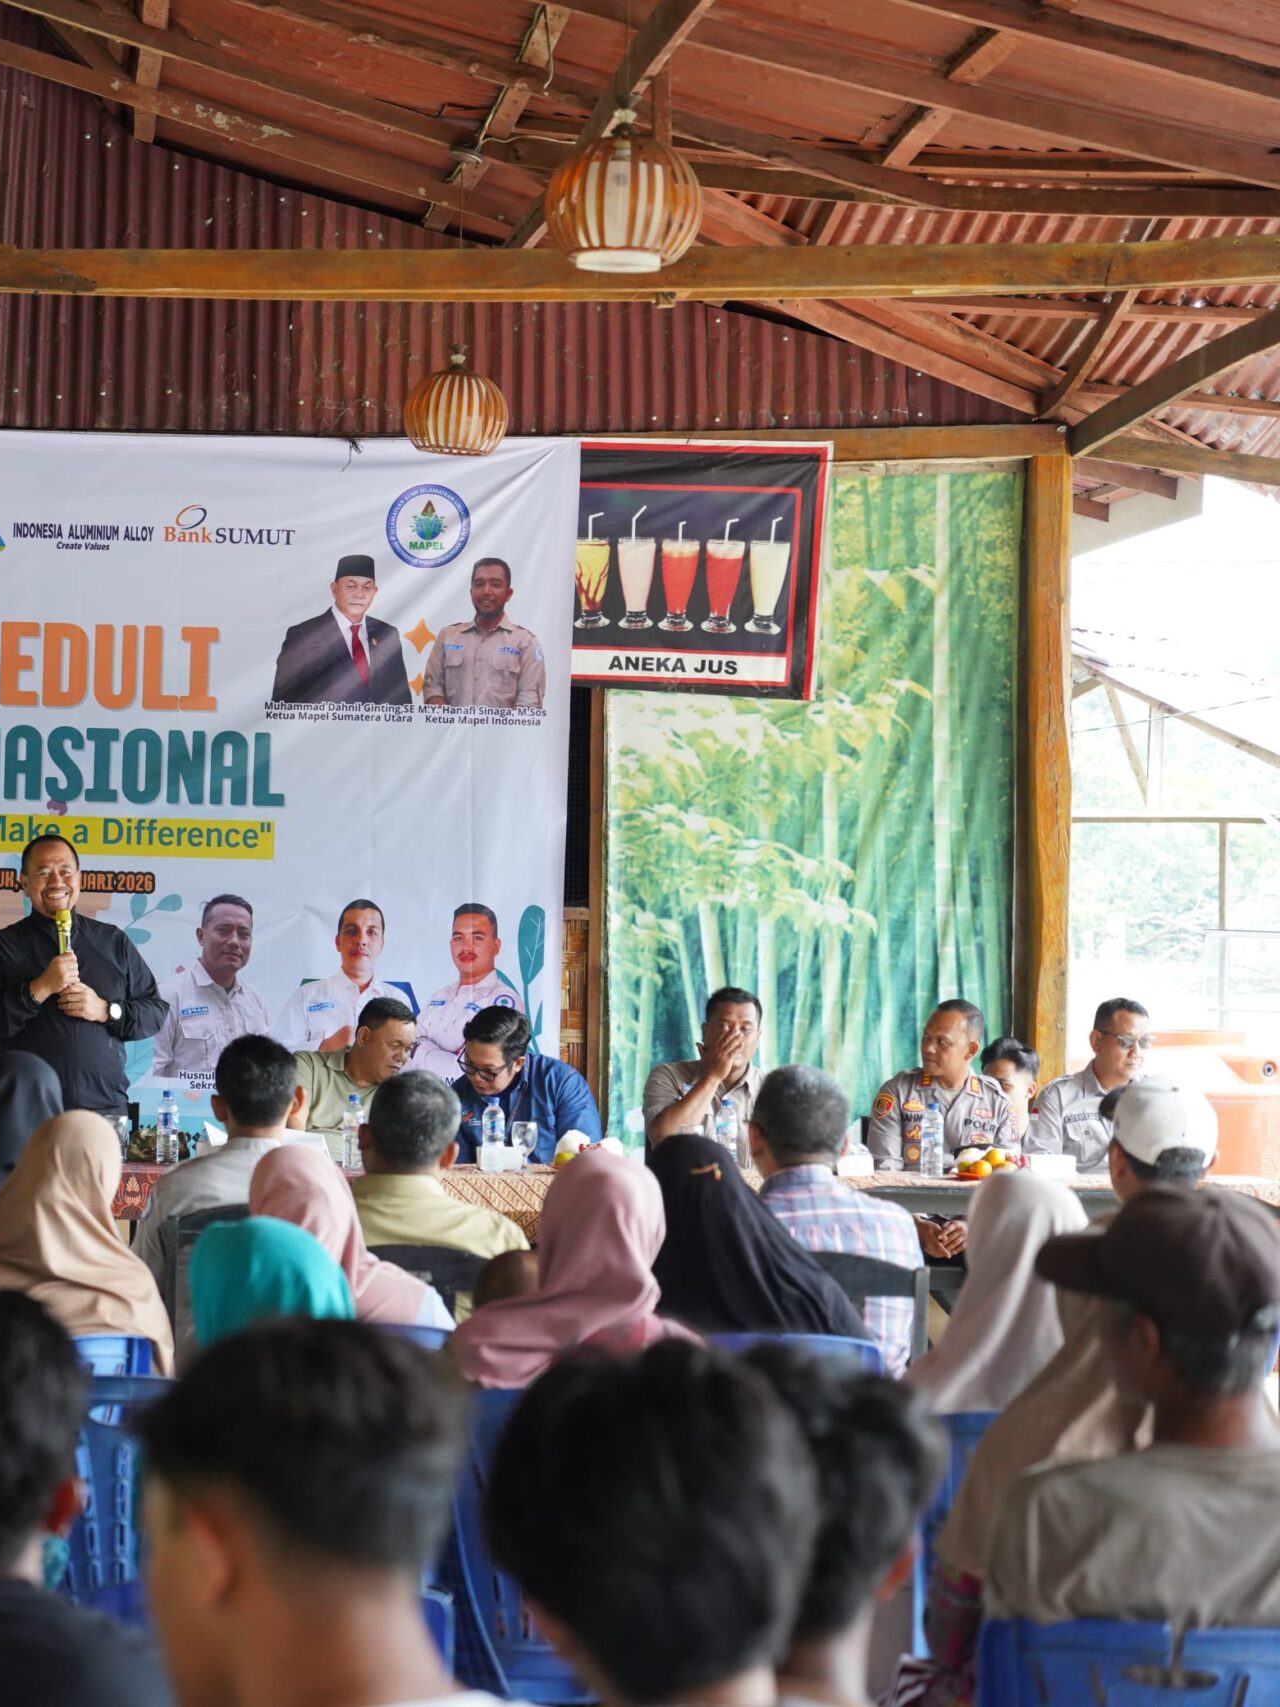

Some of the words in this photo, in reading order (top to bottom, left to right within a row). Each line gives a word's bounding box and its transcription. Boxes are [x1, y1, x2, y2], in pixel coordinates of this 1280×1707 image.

[12, 522, 63, 539] INDONESIA
[69, 524, 119, 541] ALUMINIUM
[123, 525, 154, 542] ALLOY
[56, 541, 82, 550] Create
[85, 542, 110, 551] Values
[409, 541, 445, 550] MAPEL
[608, 655, 687, 673] ANEKA
[693, 659, 738, 675] JUS
[264, 702, 325, 711] Muhammad
[328, 702, 361, 712] Dahnil
[442, 705, 476, 715] Hanafi
[478, 706, 515, 717] Sinaga,
[517, 707, 547, 717] M.Sos
[265, 711, 295, 721] Ketua
[298, 711, 329, 722] Mapel
[332, 712, 381, 722] Sumatera
[384, 713, 413, 723] Utara
[425, 715, 455, 725] Ketua
[458, 716, 489, 727] Mapel
[491, 716, 541, 727] Indonesia
[72, 823, 89, 844] a
[102, 818, 272, 850] Difference"
[80, 872, 114, 890] UARI
[117, 874, 153, 892] 2026
[190, 1080, 218, 1090] Sekre
[964, 1118, 997, 1133] POLR
